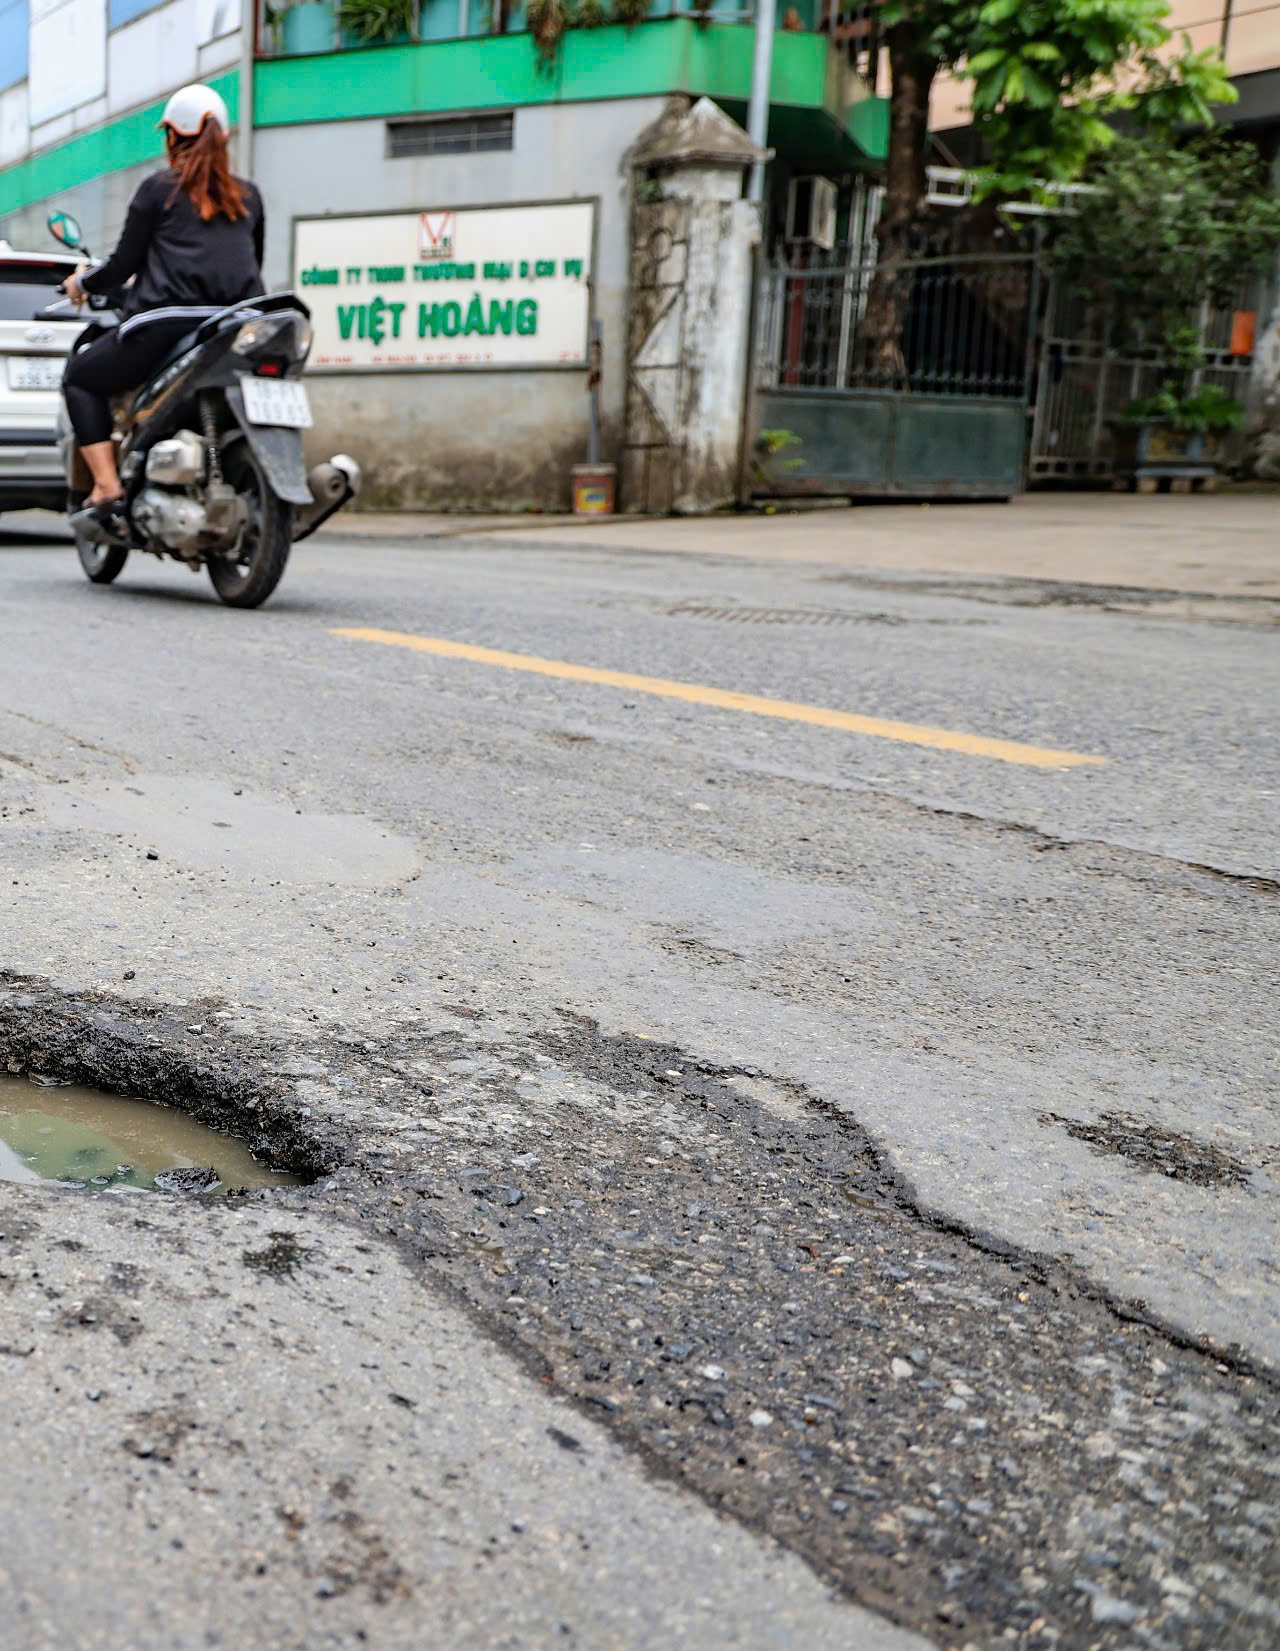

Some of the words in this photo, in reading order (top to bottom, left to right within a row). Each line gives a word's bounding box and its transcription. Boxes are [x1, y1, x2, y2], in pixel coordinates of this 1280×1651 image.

[345, 266, 362, 283] TY
[519, 259, 556, 284] DCH
[336, 295, 406, 346] VIỆT
[417, 290, 538, 338] HOÀNG
